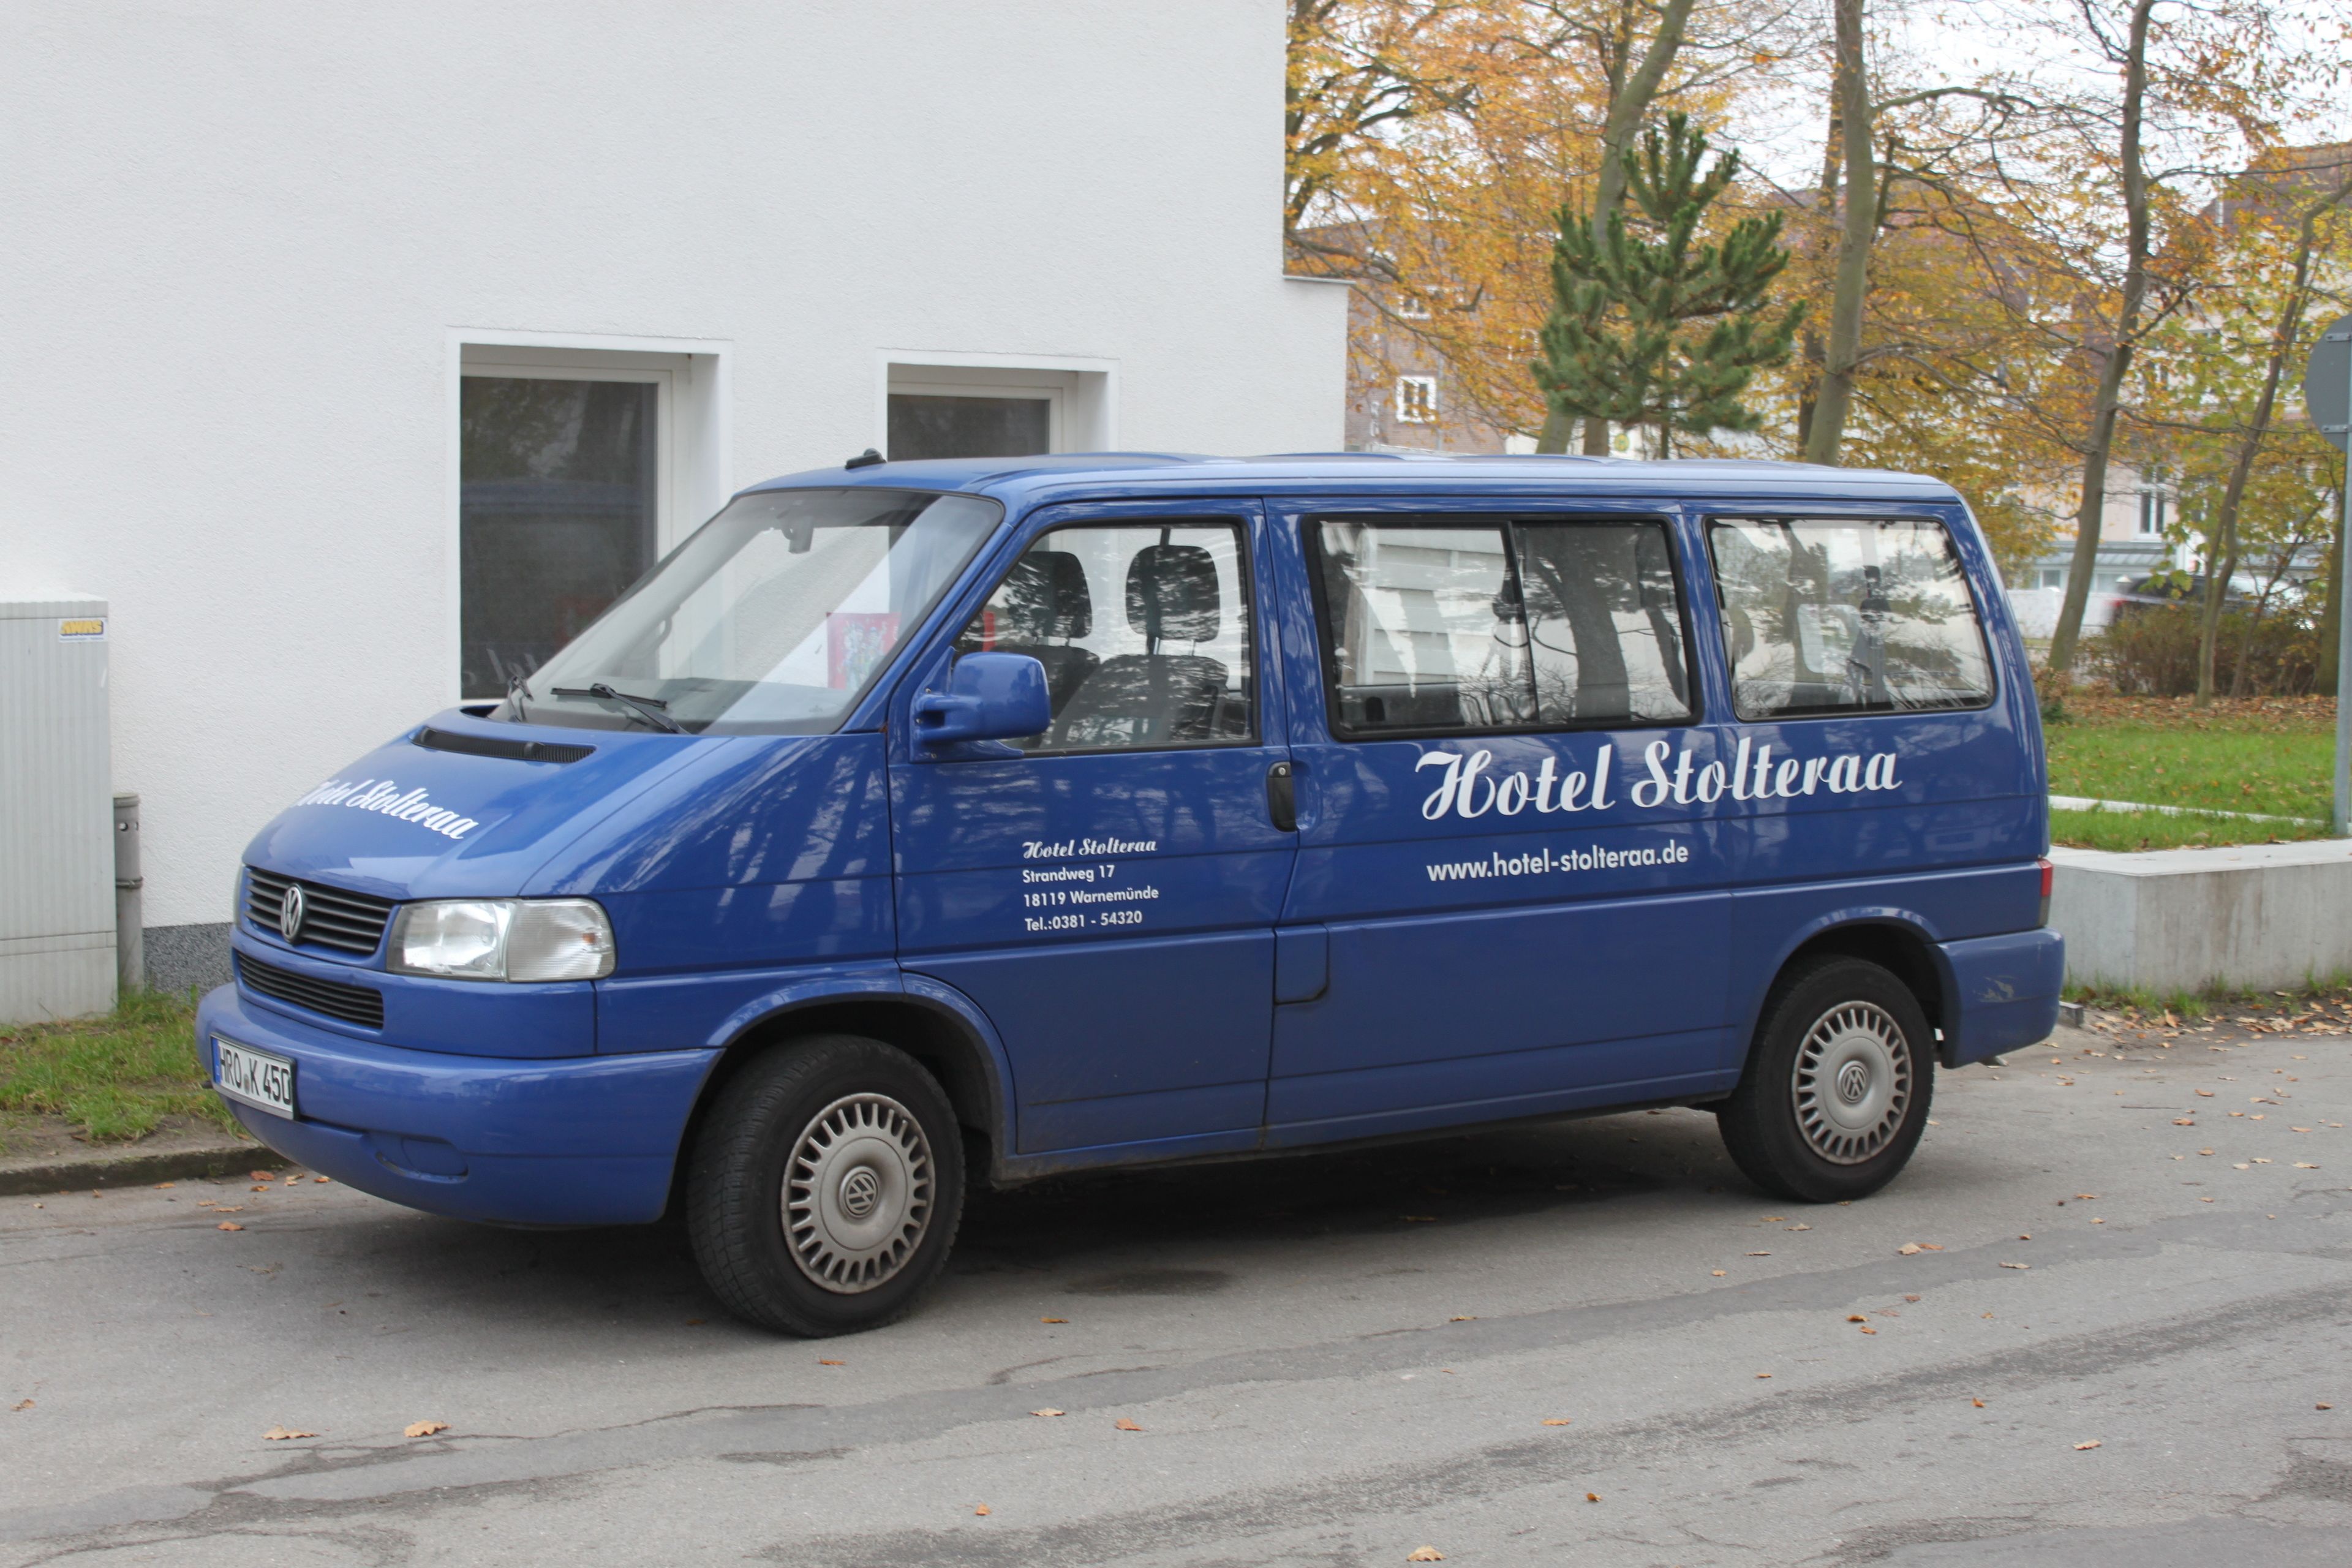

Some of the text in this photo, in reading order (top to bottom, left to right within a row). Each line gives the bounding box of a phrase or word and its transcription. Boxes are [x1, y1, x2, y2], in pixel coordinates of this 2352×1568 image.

[1414, 736, 1902, 821] Hotel Stolteraa
[345, 780, 479, 839] Stolteraa
[1022, 837, 1158, 859] Hotel Stolteraa
[1427, 840, 1689, 881] www.hotel-stolteraa.de
[1022, 864, 1115, 883] Strandweg 17
[1024, 886, 1159, 907] 18119 Warnemünde
[1024, 914, 1085, 931] Tel.:0381
[1100, 910, 1143, 926] 54320
[218, 1044, 242, 1089] HRO
[249, 1057, 260, 1096] K
